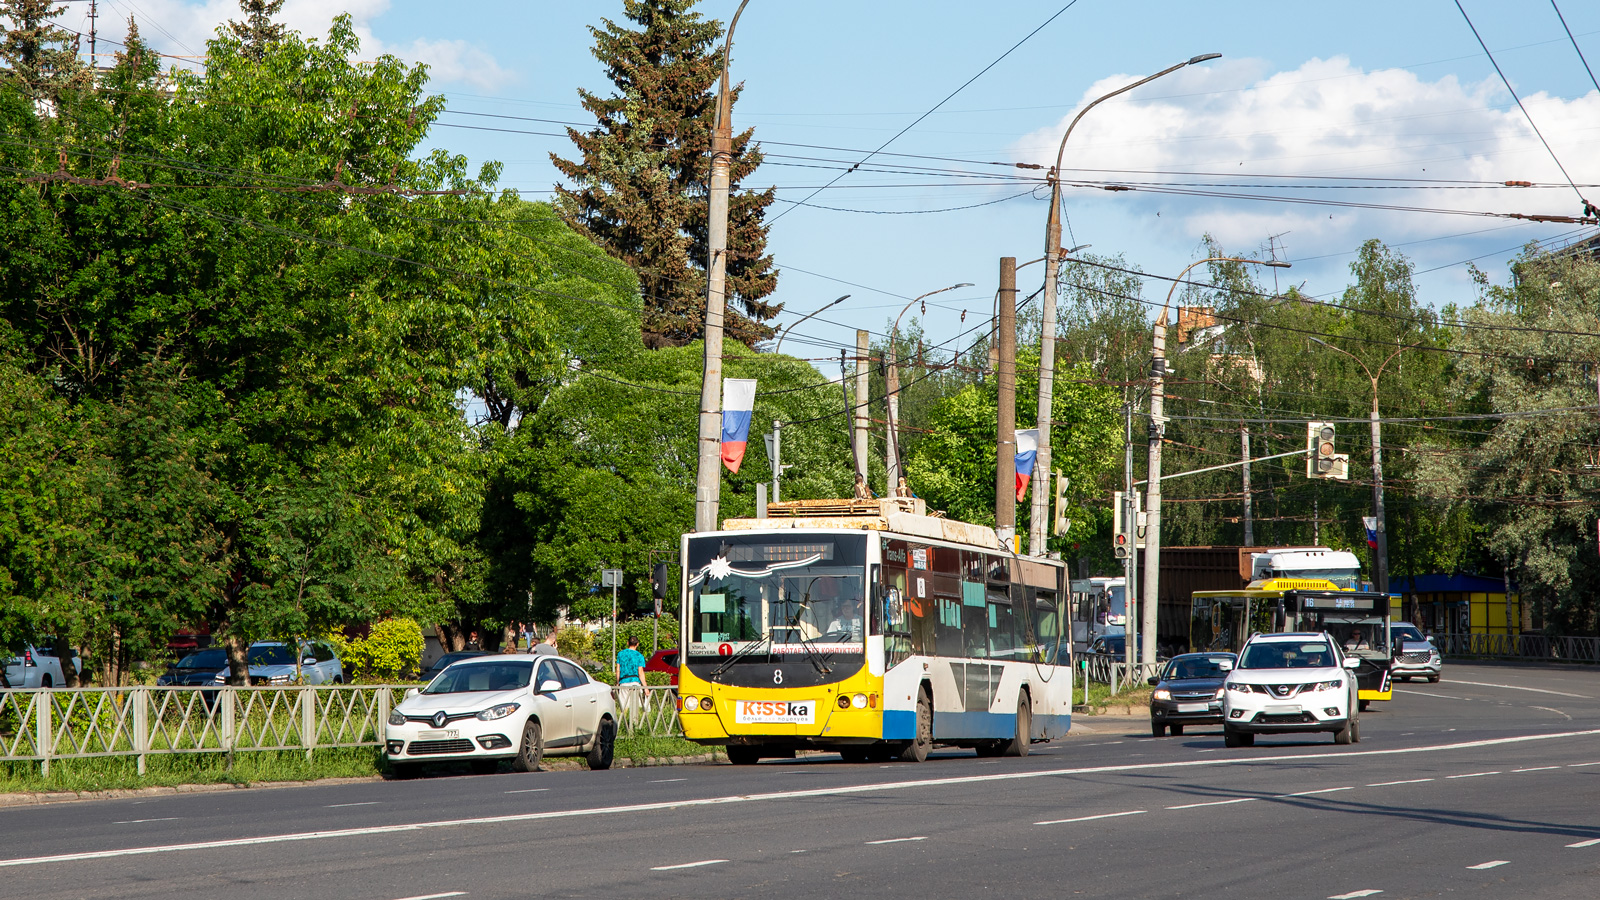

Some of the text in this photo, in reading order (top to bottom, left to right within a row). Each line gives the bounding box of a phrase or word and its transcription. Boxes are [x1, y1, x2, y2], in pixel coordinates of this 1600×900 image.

[886, 546, 906, 562] Trans-Alfa
[1305, 598, 1314, 607] 16
[773, 669, 783, 685] 8
